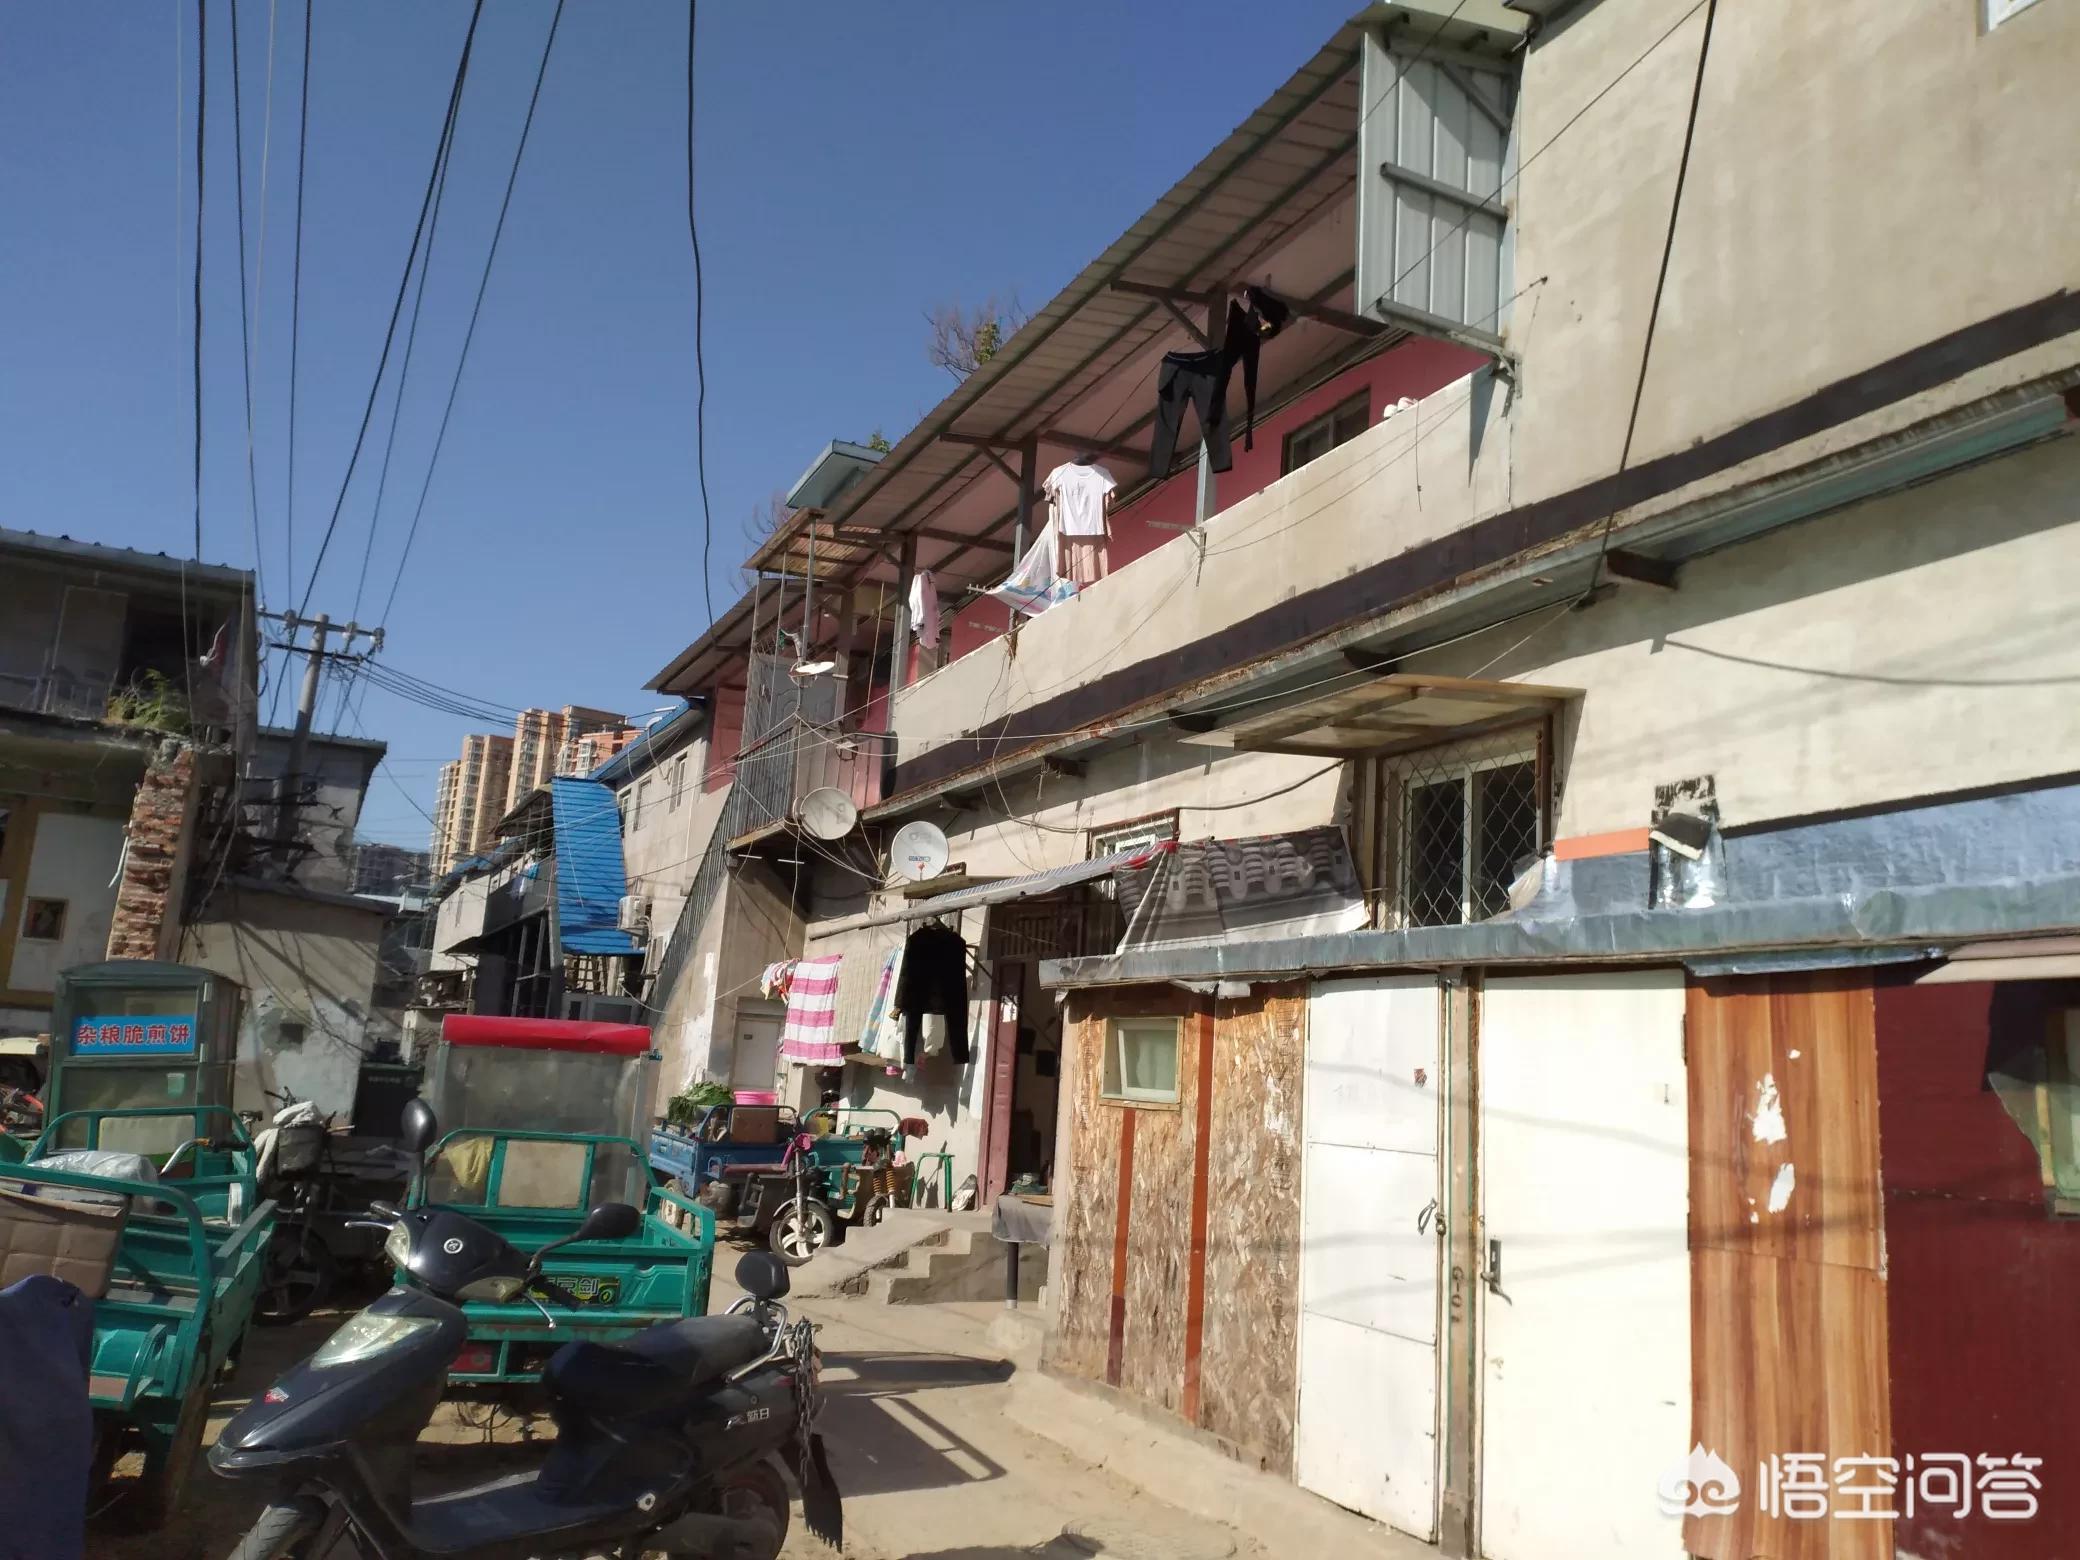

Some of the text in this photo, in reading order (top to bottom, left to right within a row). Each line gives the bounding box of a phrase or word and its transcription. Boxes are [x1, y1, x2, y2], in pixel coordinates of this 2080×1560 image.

[77, 1022, 191, 1045] 杂粮脆煎饼
